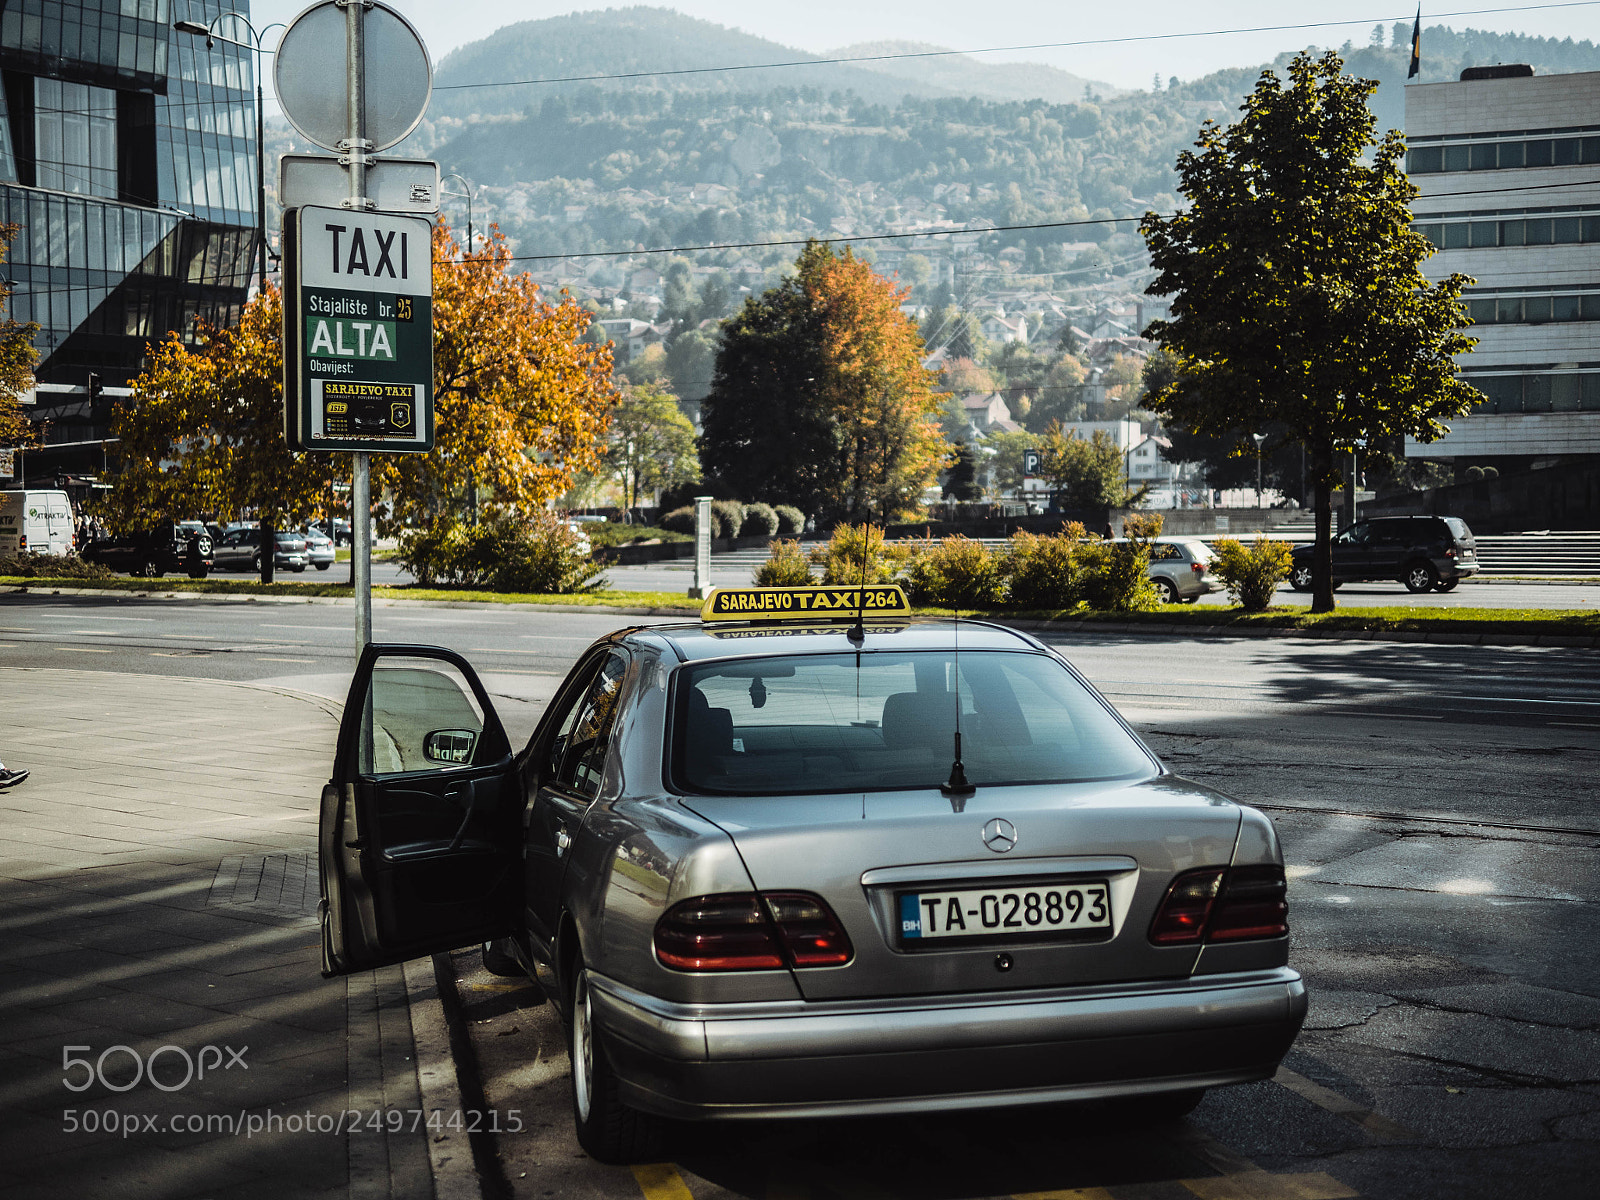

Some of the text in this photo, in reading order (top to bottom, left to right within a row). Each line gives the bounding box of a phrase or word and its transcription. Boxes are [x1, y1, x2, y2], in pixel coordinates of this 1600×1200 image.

[325, 223, 408, 280] TAXI
[310, 295, 411, 319] Stajalište br. 25
[310, 319, 393, 358] ALTA
[310, 360, 354, 375] Obavijest:
[326, 384, 412, 396] SARAJEVO TAXI
[1028, 455, 1037, 471] P
[721, 591, 898, 610] SARAJEVO TAXI 264
[902, 889, 1106, 932] BIH TA-028893
